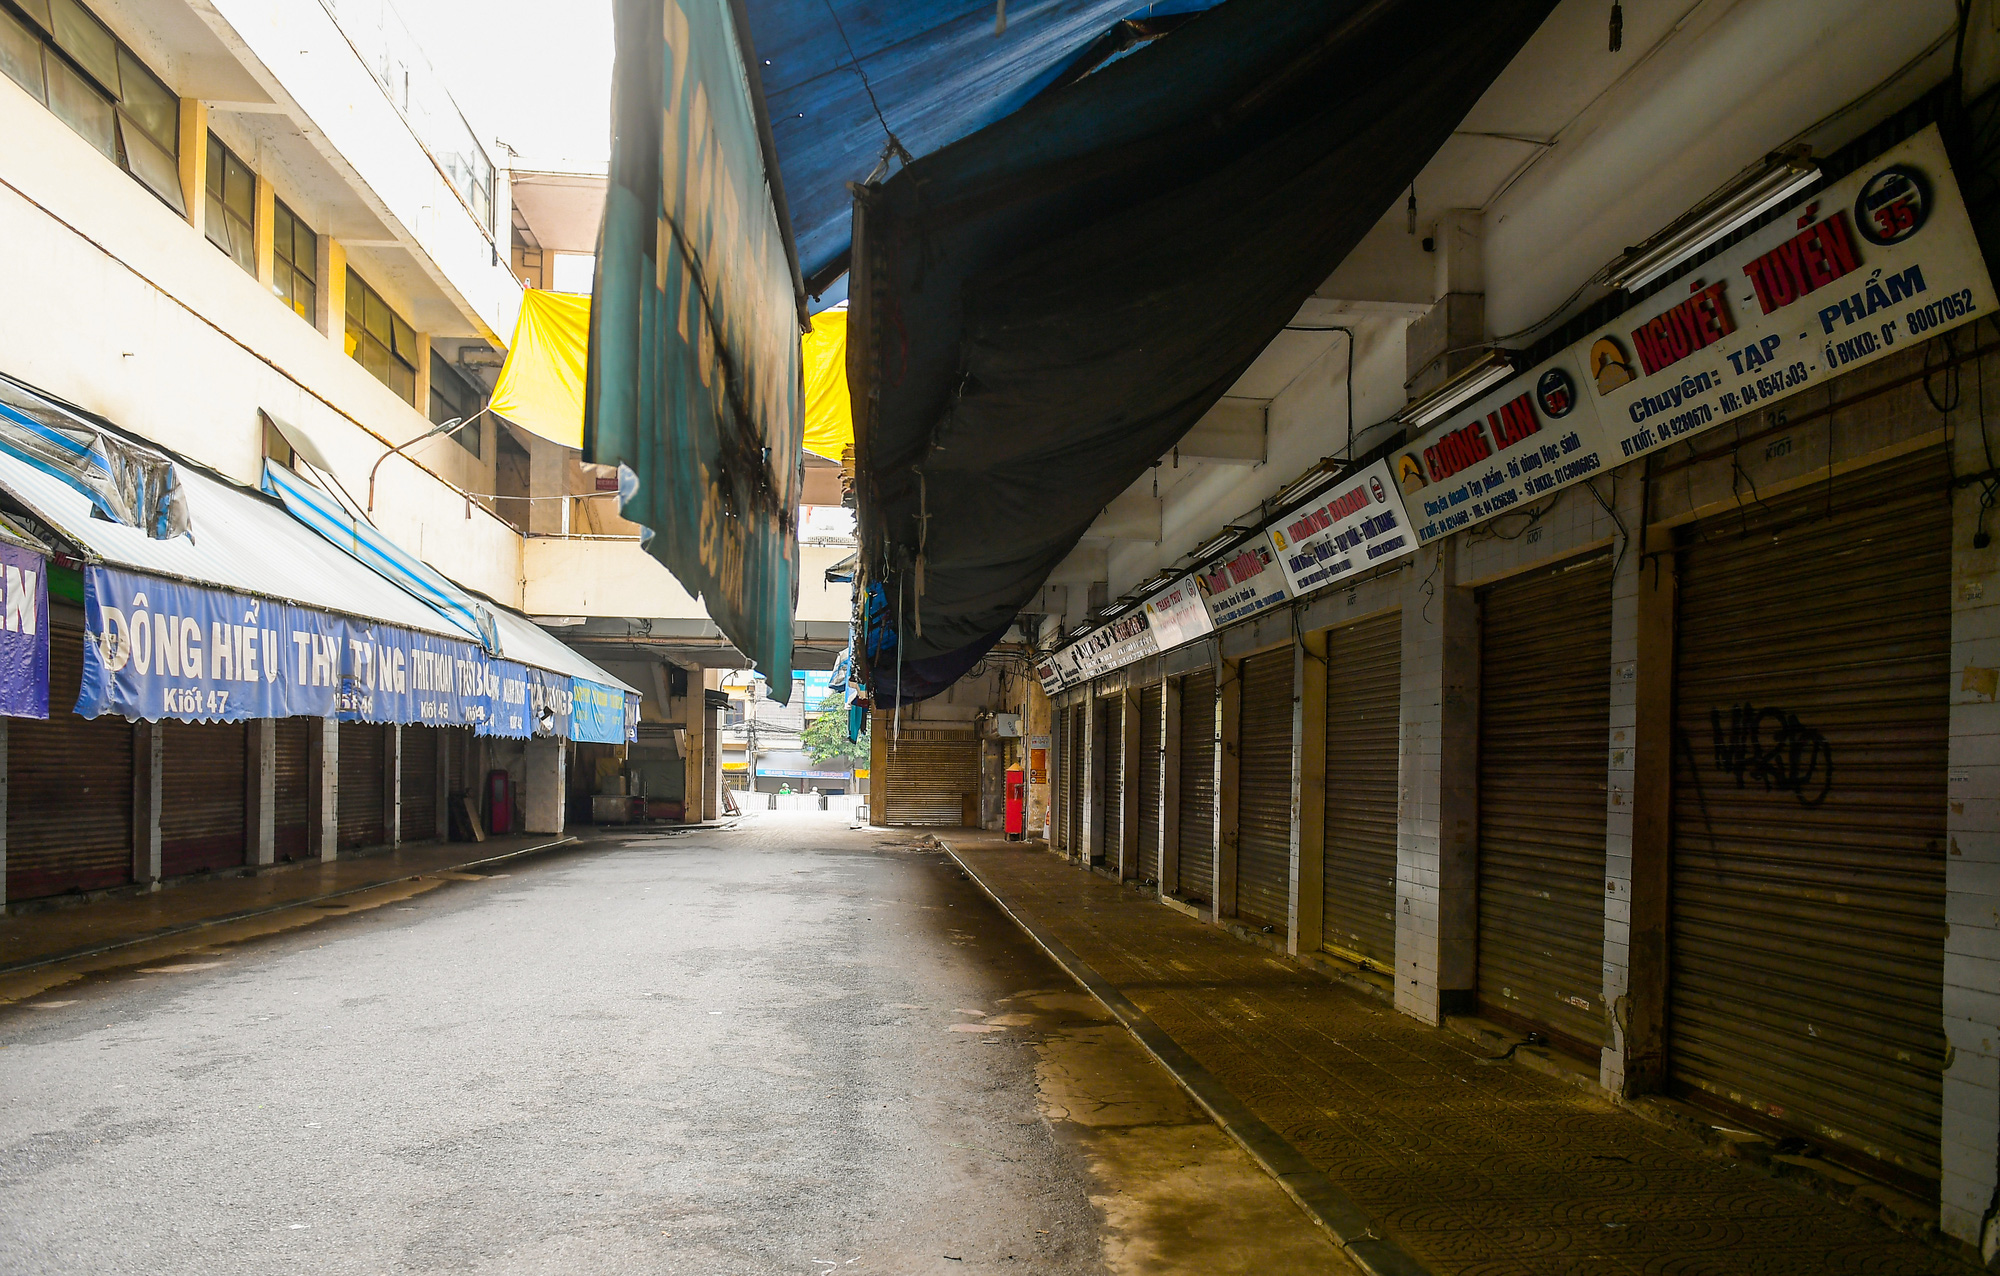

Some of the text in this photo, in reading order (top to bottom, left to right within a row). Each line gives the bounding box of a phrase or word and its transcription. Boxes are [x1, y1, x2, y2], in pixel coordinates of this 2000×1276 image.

[1874, 199, 1916, 240] 35
[1628, 368, 1721, 424] Chuyên:
[1727, 333, 1781, 375] TẠP
[1818, 264, 1928, 336] PHẨM
[1657, 423, 1671, 442] 04
[1719, 391, 1742, 415] NR:
[1741, 385, 1758, 406] 04
[1906, 287, 1976, 337] 8007052
[1487, 390, 1541, 451] LAN
[1540, 444, 1560, 465] Học
[100, 592, 203, 680] ĐÔNG
[163, 686, 229, 714] Kiốt 47
[361, 696, 373, 715] 46
[420, 699, 449, 719] Kiốt 45
